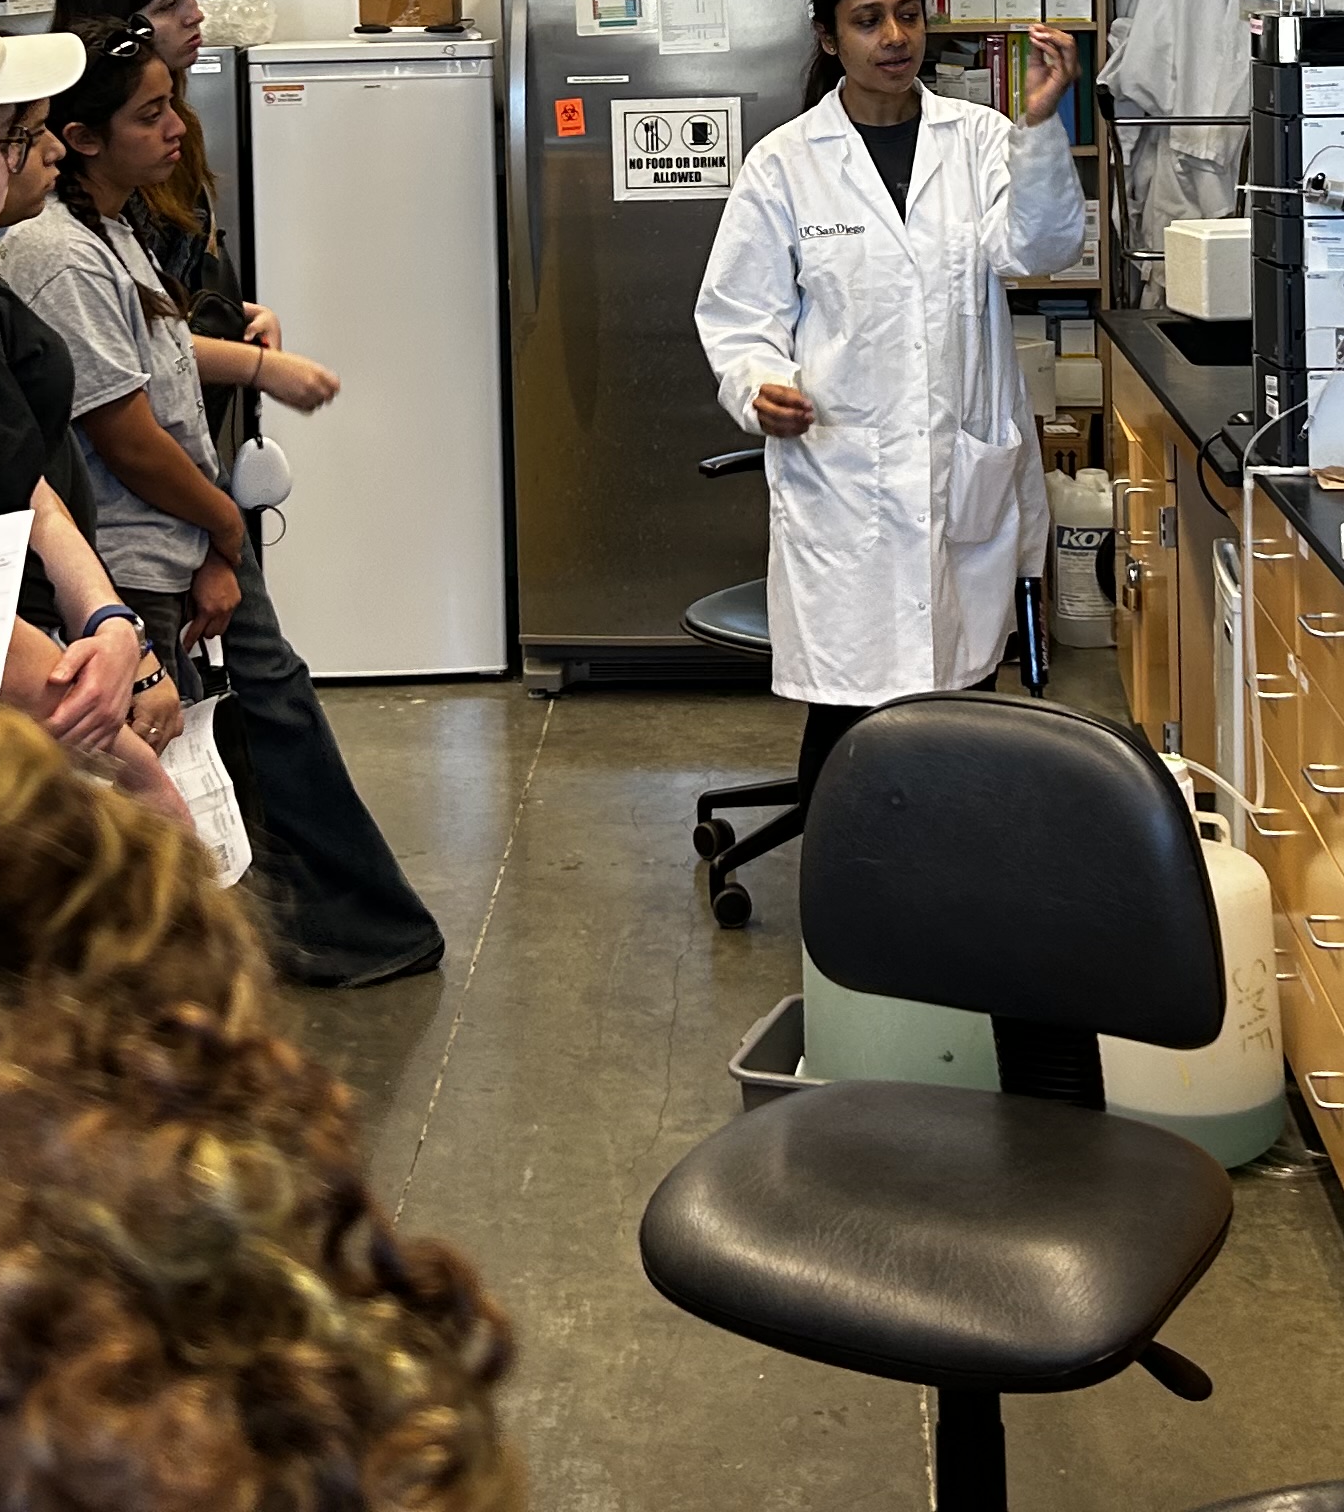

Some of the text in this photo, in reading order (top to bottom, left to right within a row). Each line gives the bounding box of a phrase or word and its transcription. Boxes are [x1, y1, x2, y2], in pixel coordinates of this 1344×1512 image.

[629, 156, 726, 169] NO FOOD OR DRINK
[653, 172, 702, 183] ALLOWED
[799, 223, 865, 238] UC San Diego
[1062, 530, 1110, 548] KO
